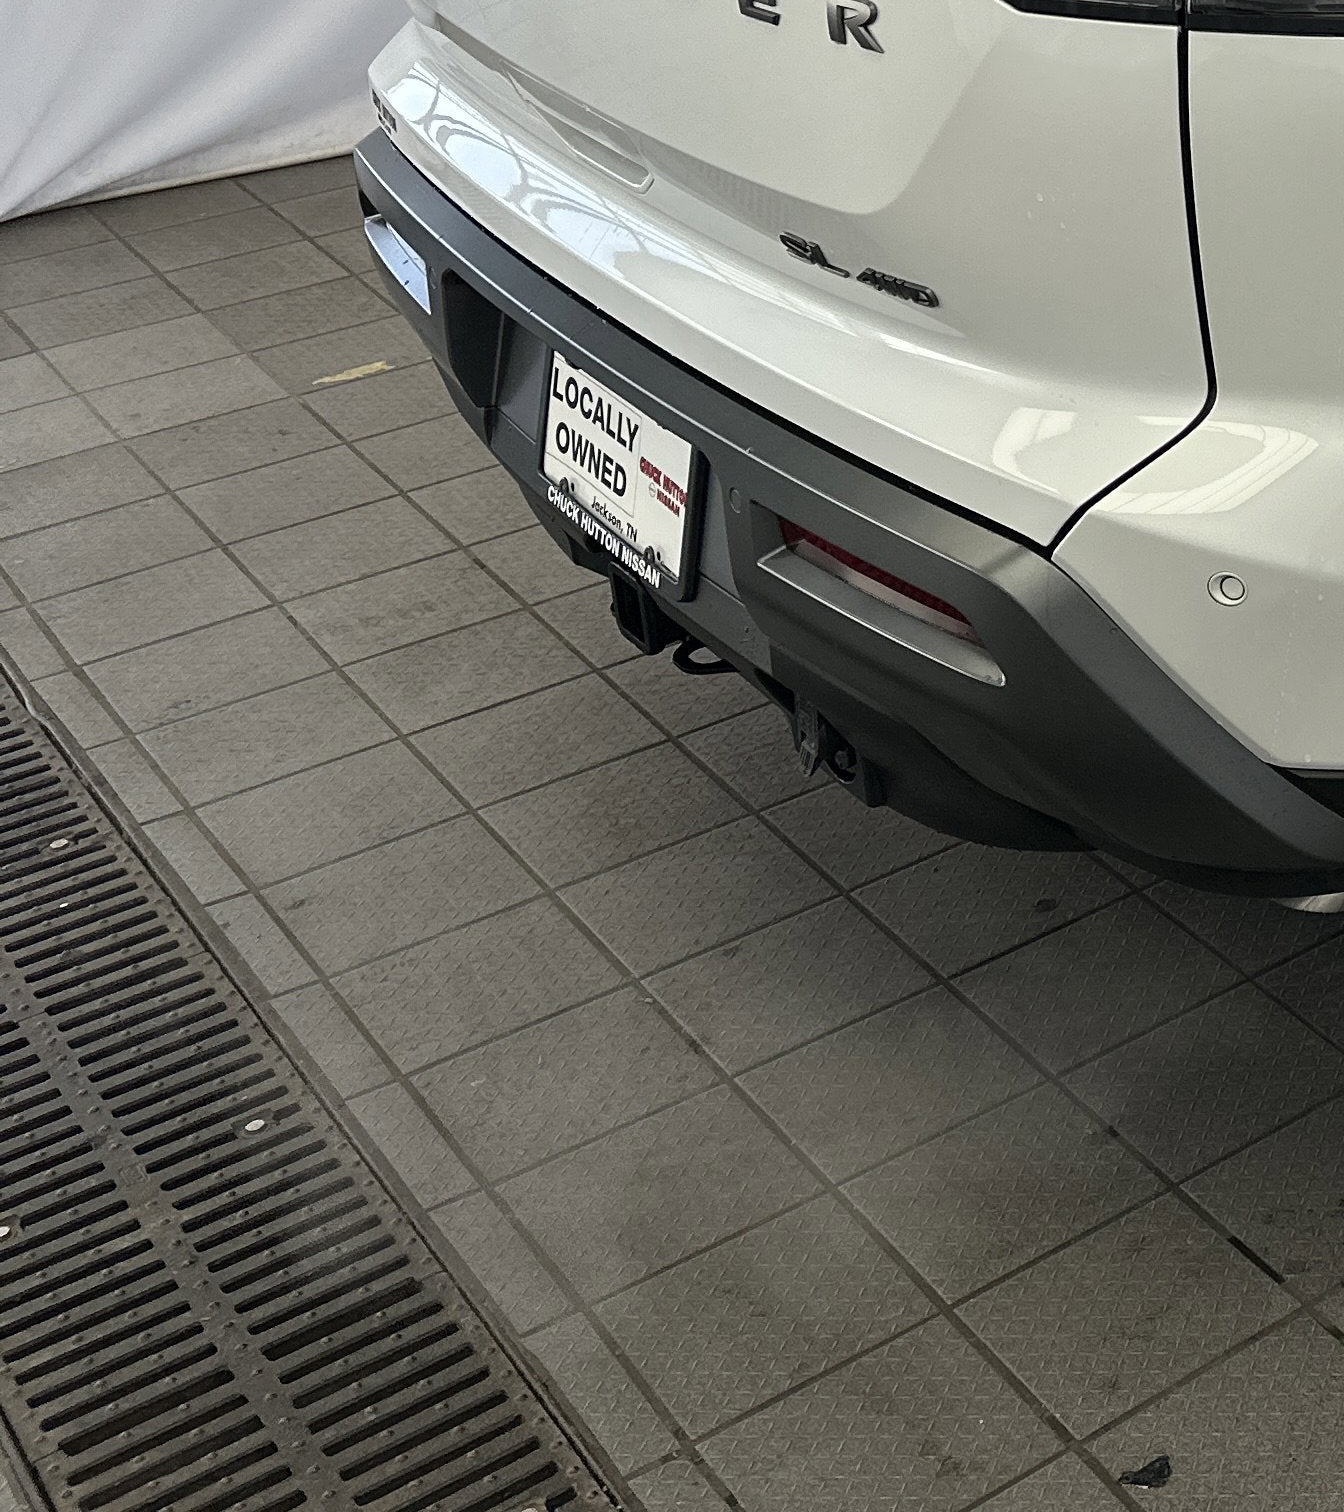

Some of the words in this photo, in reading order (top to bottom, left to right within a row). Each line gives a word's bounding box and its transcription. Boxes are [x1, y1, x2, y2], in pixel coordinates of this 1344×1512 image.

[779, 231, 851, 278] SL
[552, 367, 639, 453] LOCALLY
[555, 421, 628, 498] OWNED
[639, 456, 662, 487] CHUCK
[547, 485, 581, 526] CHUCK
[580, 512, 620, 558] HUTTON
[621, 544, 660, 589] NISSAN
[591, 495, 624, 534] Jackson,
[626, 522, 638, 543] TN
